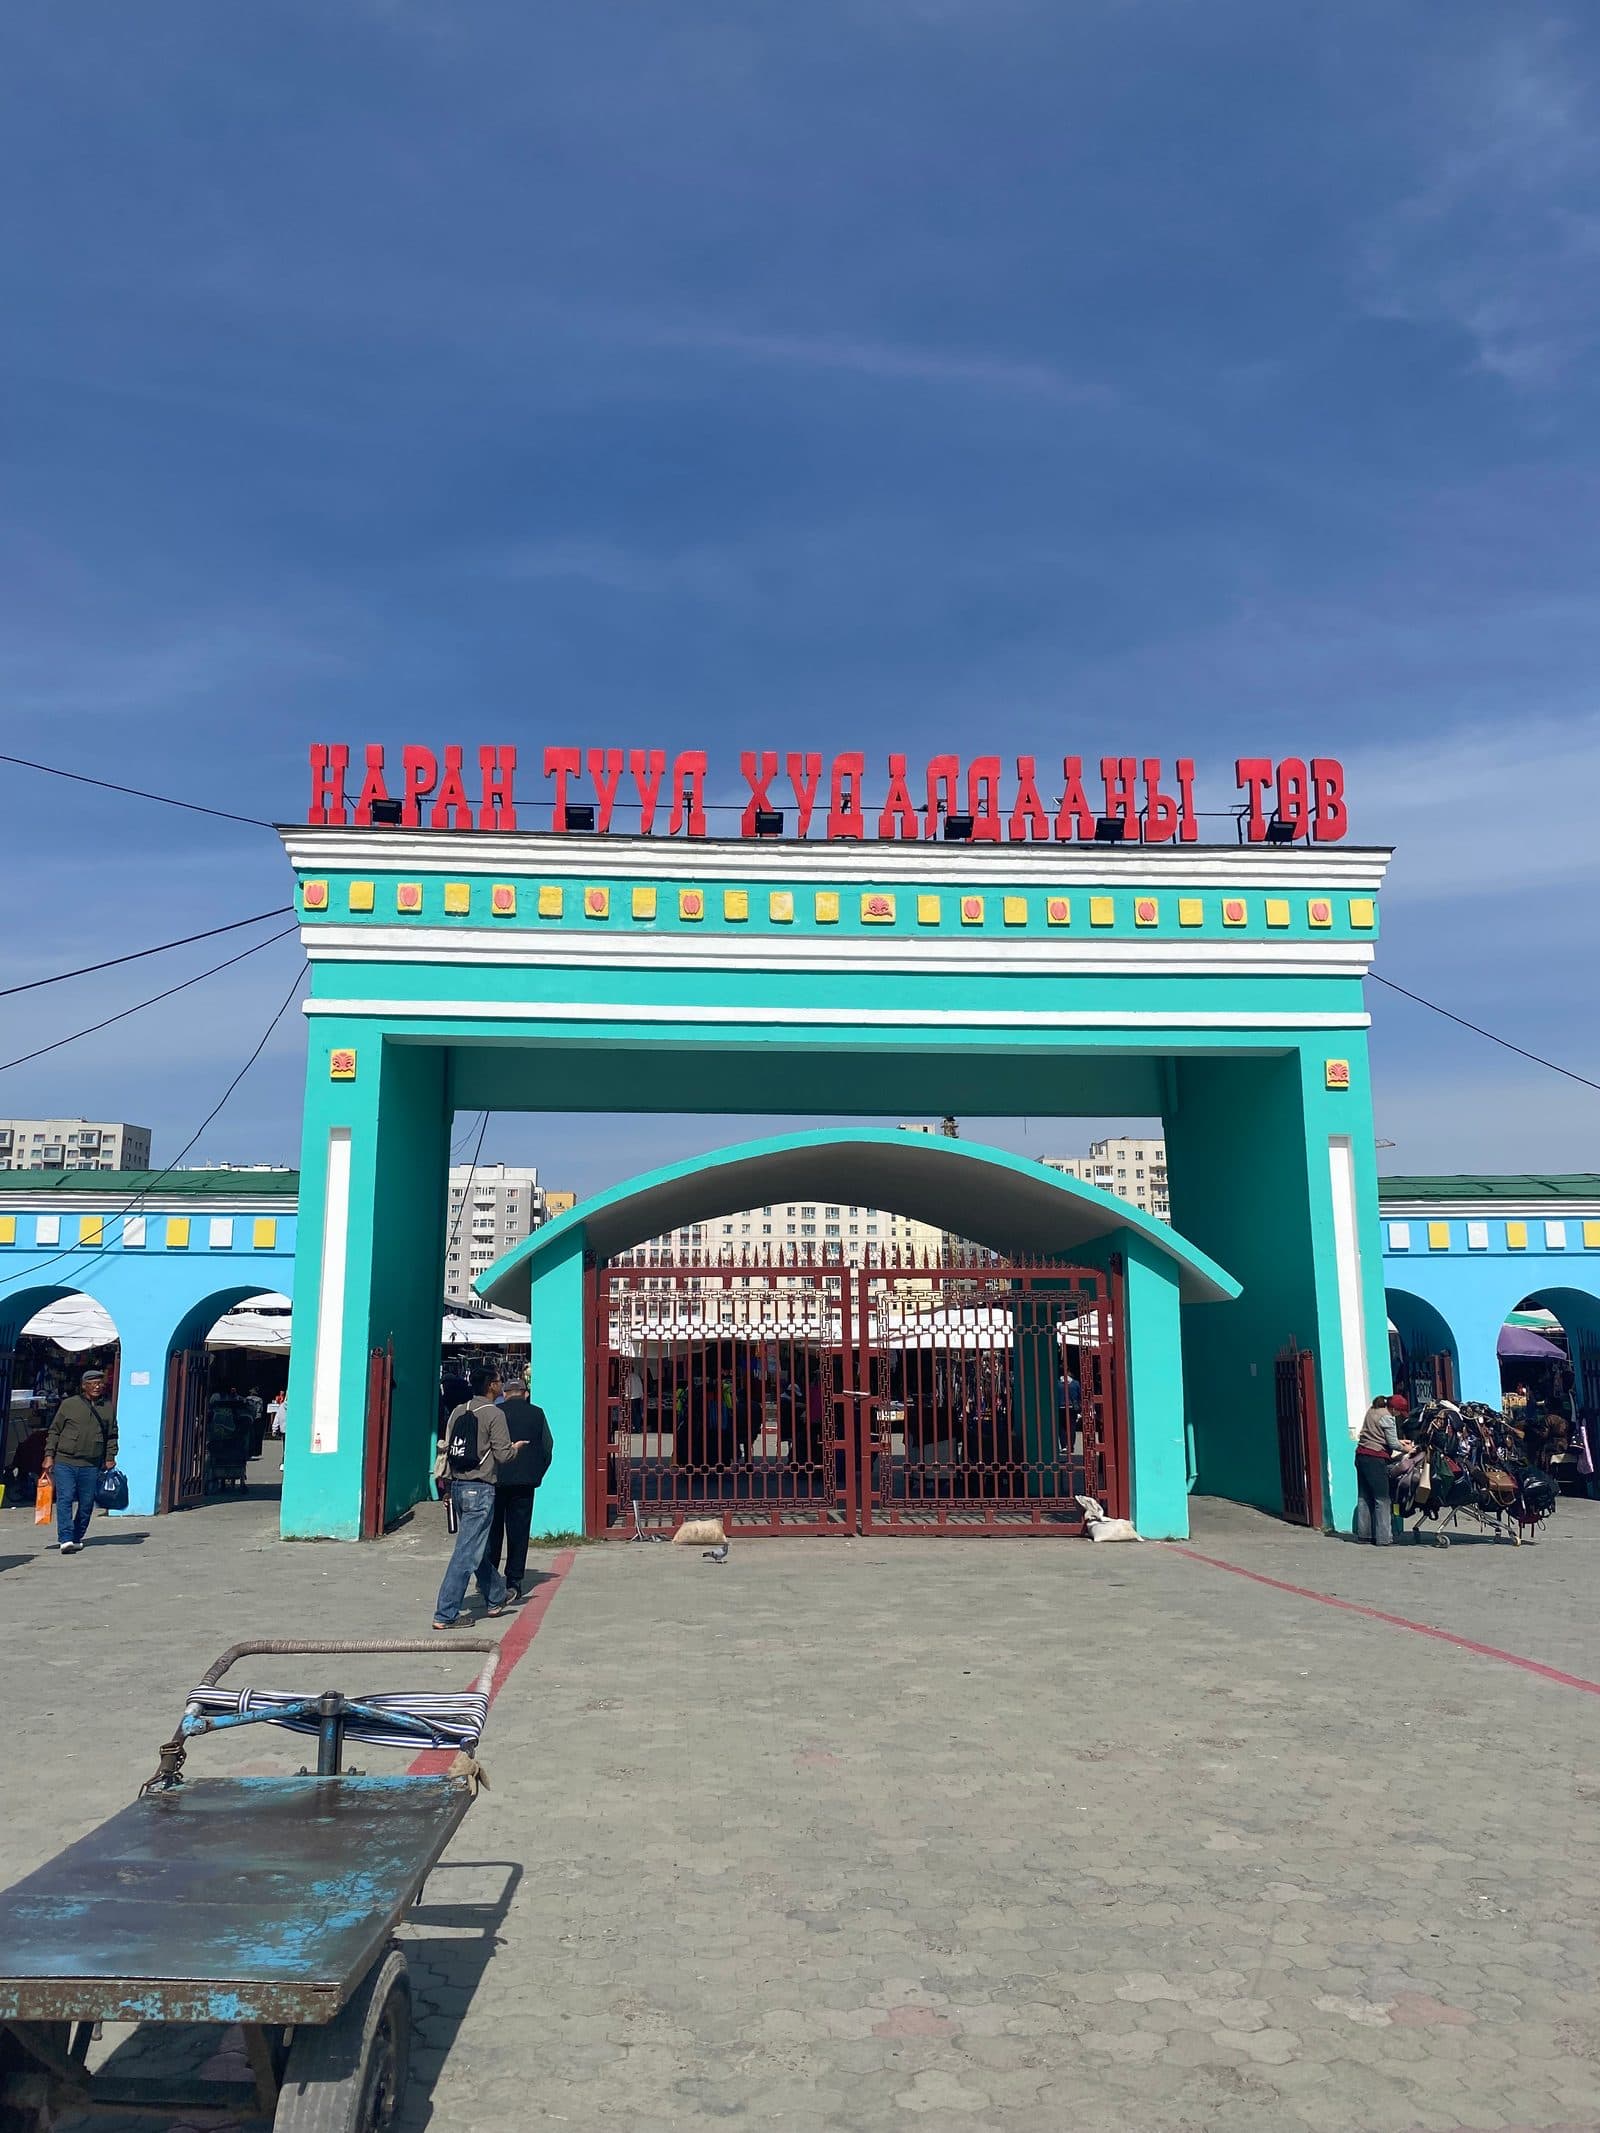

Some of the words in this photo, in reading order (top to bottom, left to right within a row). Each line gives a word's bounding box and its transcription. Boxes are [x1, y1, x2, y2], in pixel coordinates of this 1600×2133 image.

[308, 743, 517, 831] НАРАН
[543, 747, 707, 836] ТУУЛ
[740, 751, 1196, 842] ХУДАЛДААНЫ
[1235, 757, 1347, 842] ТӨВ
